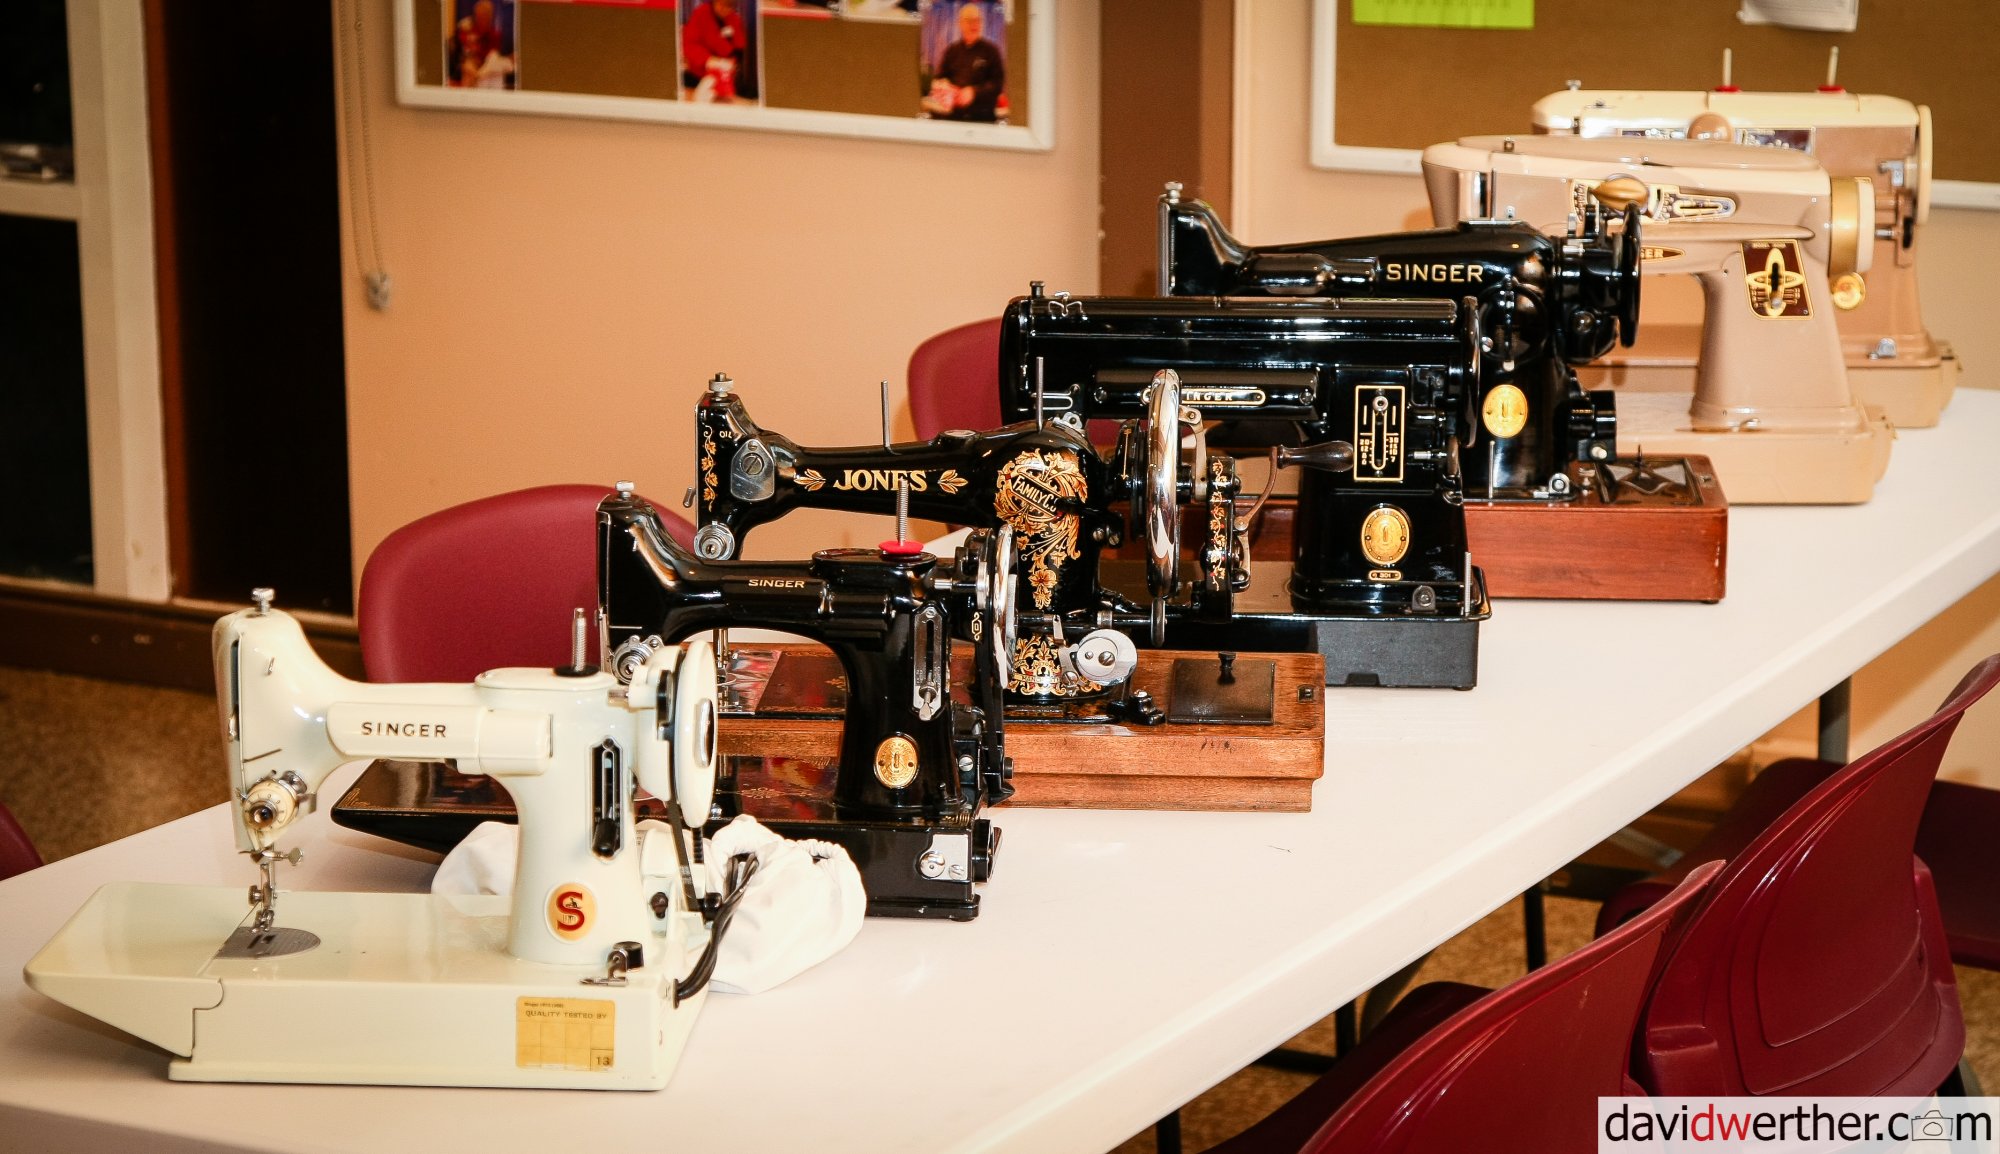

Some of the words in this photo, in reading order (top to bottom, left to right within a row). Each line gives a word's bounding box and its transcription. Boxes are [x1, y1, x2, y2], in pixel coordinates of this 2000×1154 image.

[1386, 263, 1483, 282] SINGER
[1186, 391, 1232, 401] INGER
[719, 431, 732, 439] OIL
[833, 469, 928, 491] JONES
[748, 579, 805, 588] SINGER
[361, 722, 446, 738] SINGER
[556, 891, 585, 931] S
[596, 1056, 610, 1066] 13
